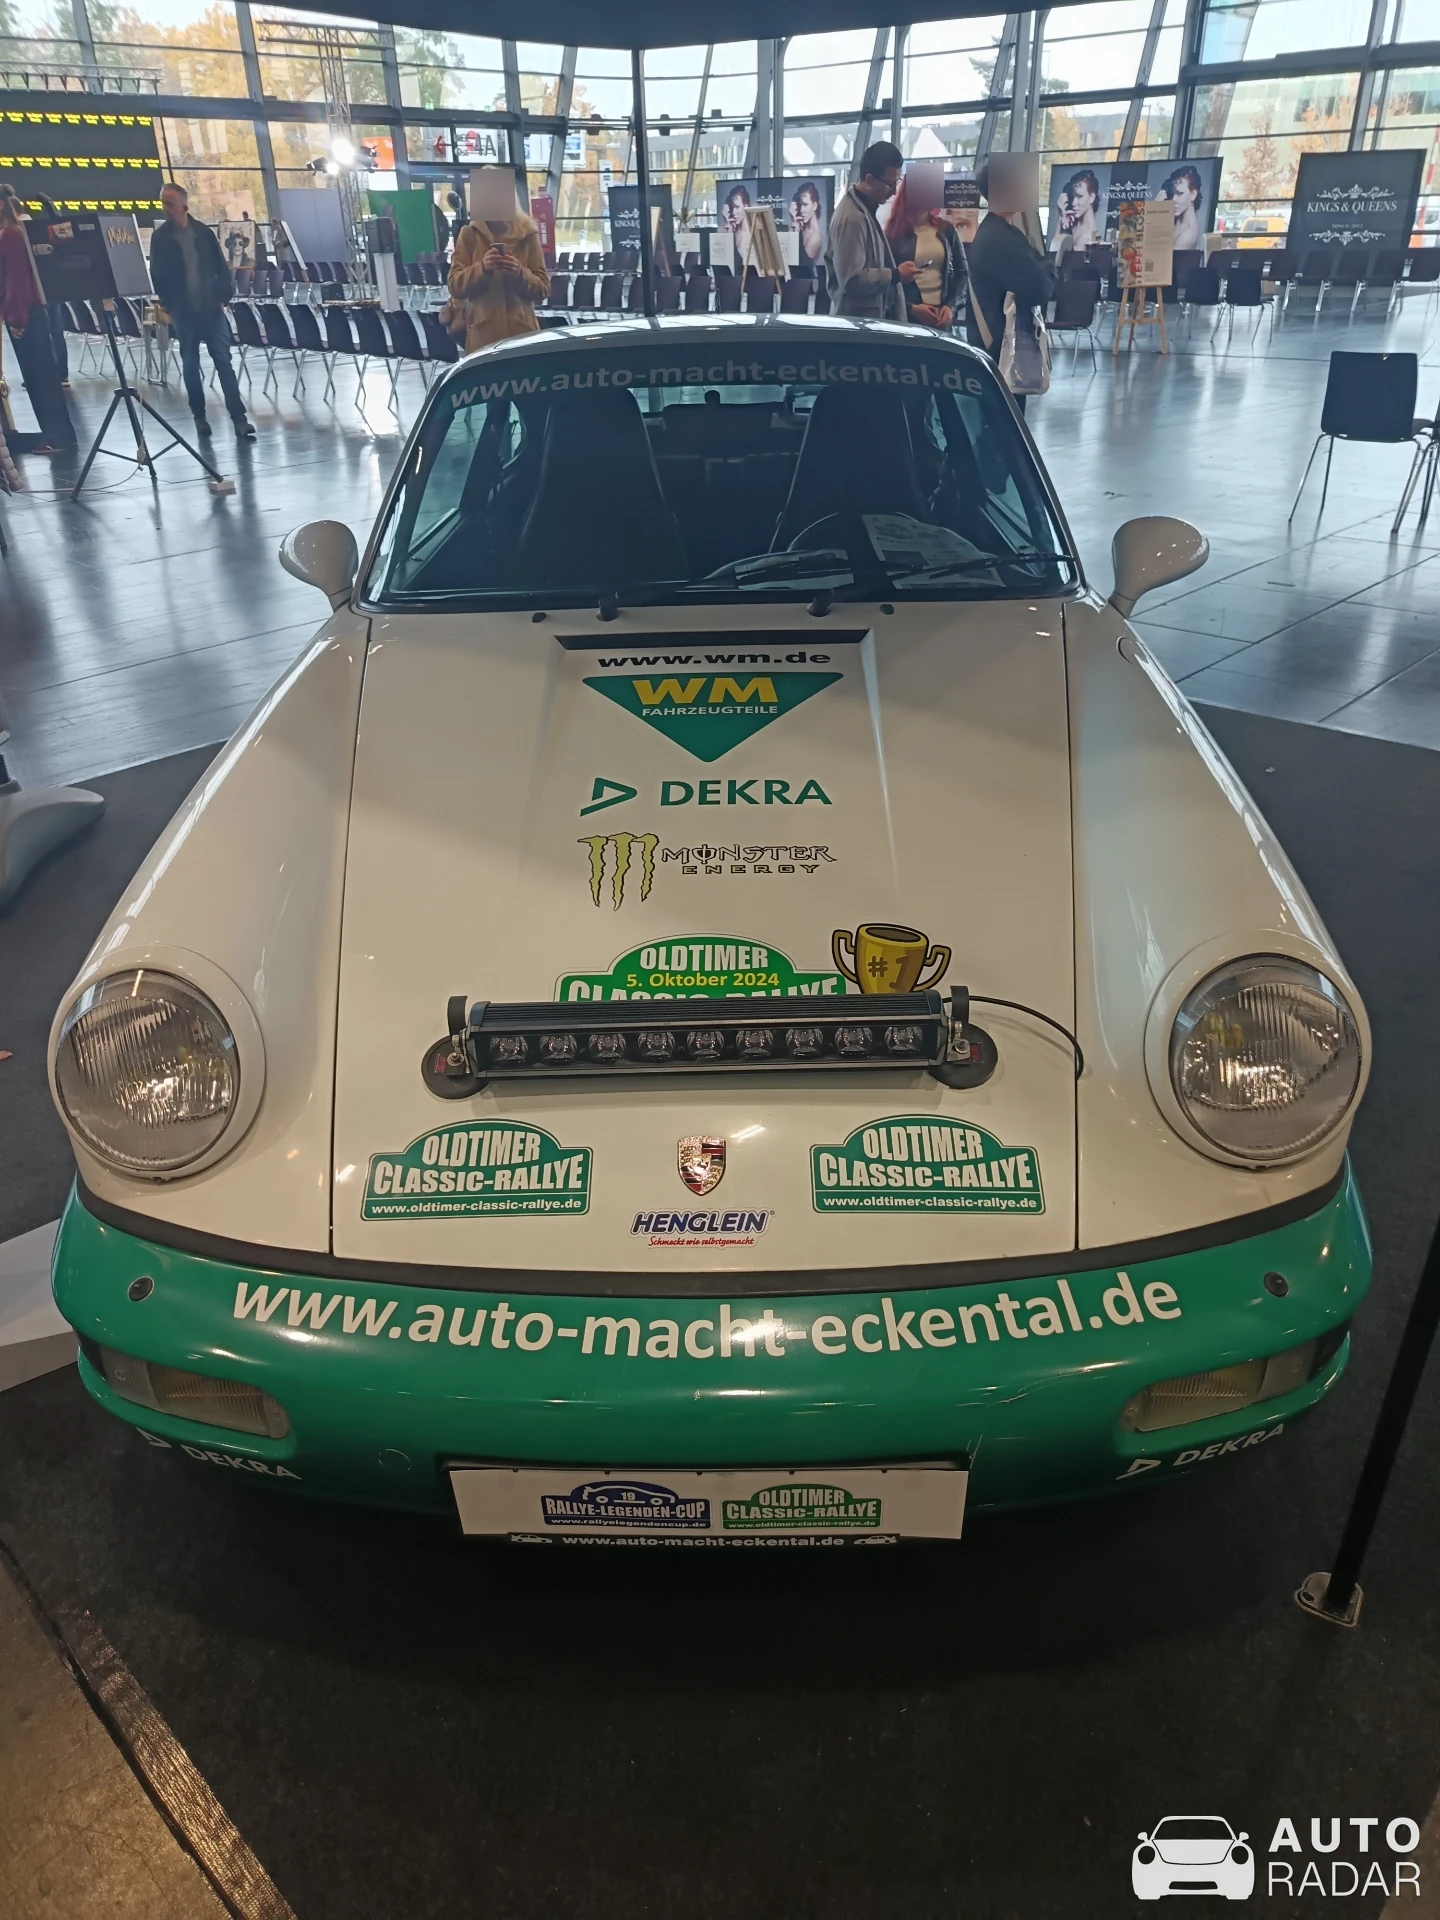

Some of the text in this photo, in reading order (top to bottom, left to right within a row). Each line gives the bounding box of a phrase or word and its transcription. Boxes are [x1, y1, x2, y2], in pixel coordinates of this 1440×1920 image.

[1127, 190, 1153, 200] QUEENS
[1306, 200, 1398, 214] KINGS & QUEENS
[451, 359, 983, 408] www.auto-macht-eckental.de
[598, 651, 831, 667] www.wm.de
[632, 677, 779, 705] WM
[642, 705, 779, 716] FAHRZEUGTEILE
[660, 779, 833, 806] DEKRA
[661, 843, 837, 864] MONSTER
[682, 864, 819, 875] ENERGY
[639, 944, 769, 972] OLDTIMER
[626, 973, 780, 987] 5. Oktober 2024
[422, 1130, 541, 1167] OLDTIMER
[862, 1125, 984, 1162] OLDTIMER
[373, 1153, 584, 1195] CLASSIC-RALLYE
[819, 1152, 1033, 1188] CLASSIC-RALLYE
[371, 1199, 582, 1214] www.oldtimer-classic-rallye.de
[823, 1196, 1037, 1209] www.oldtimer-classic-rallye.de
[632, 1210, 767, 1233] HENGLEIN
[648, 1236, 755, 1247] Schmeckt wie selbstgemacht
[232, 1271, 1182, 1358] www.auto-macht-eckental.de
[1172, 1422, 1284, 1466] DEKRA
[180, 1444, 303, 1480] DEKRA
[620, 1491, 636, 1500] 19
[758, 1488, 845, 1507] OLDTIMER
[545, 1497, 705, 1518] RALLYE-LEGENDEN-CUP
[726, 1500, 877, 1520] CLASSIC-RALLYE
[551, 1518, 707, 1528] www.rallyelegendencup.de
[728, 1520, 876, 1529] www.oldtimer-classic-rallye.de
[562, 1536, 845, 1547] www.auto-macht-eckental.de
